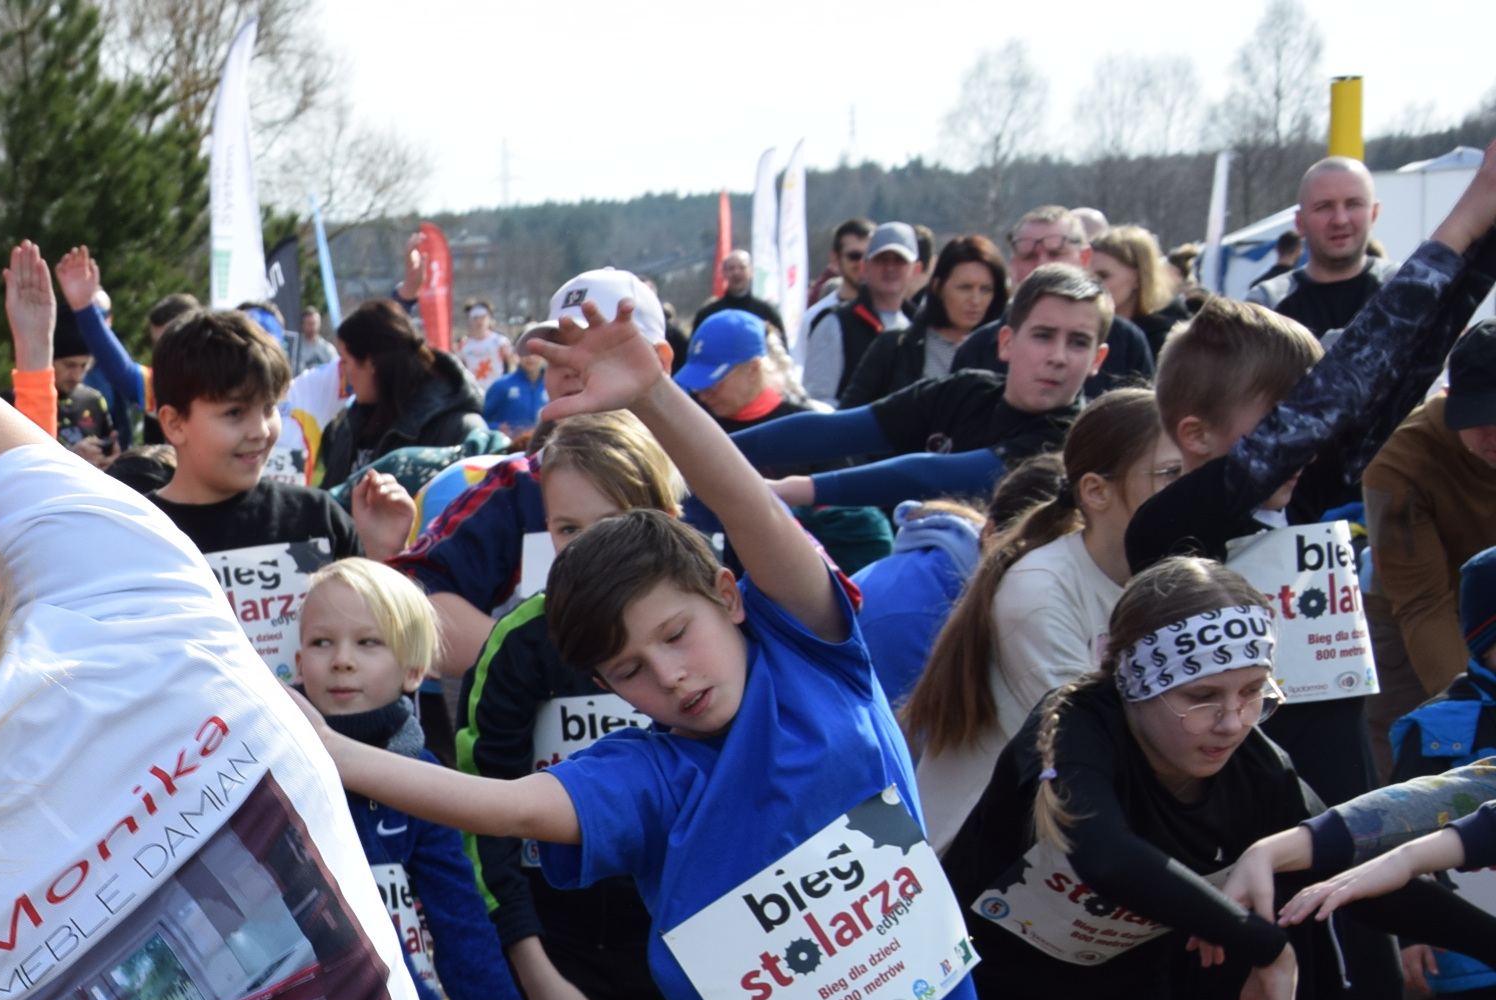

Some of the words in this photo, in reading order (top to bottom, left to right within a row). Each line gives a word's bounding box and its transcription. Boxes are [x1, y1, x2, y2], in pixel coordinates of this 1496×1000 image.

[1174, 617, 1272, 655] SCOU
[1308, 632, 1332, 645] Bieg
[1335, 630, 1349, 641] dla
[1316, 648, 1336, 661] 800
[133, 740, 259, 879] DAMIAN
[742, 843, 865, 934] bieg
[988, 901, 1003, 914] 5
[876, 896, 914, 936] edycja
[817, 978, 849, 1000] Bieg
[848, 963, 869, 981] dla
[868, 937, 901, 967] dzieci
[863, 959, 906, 995] metrów
